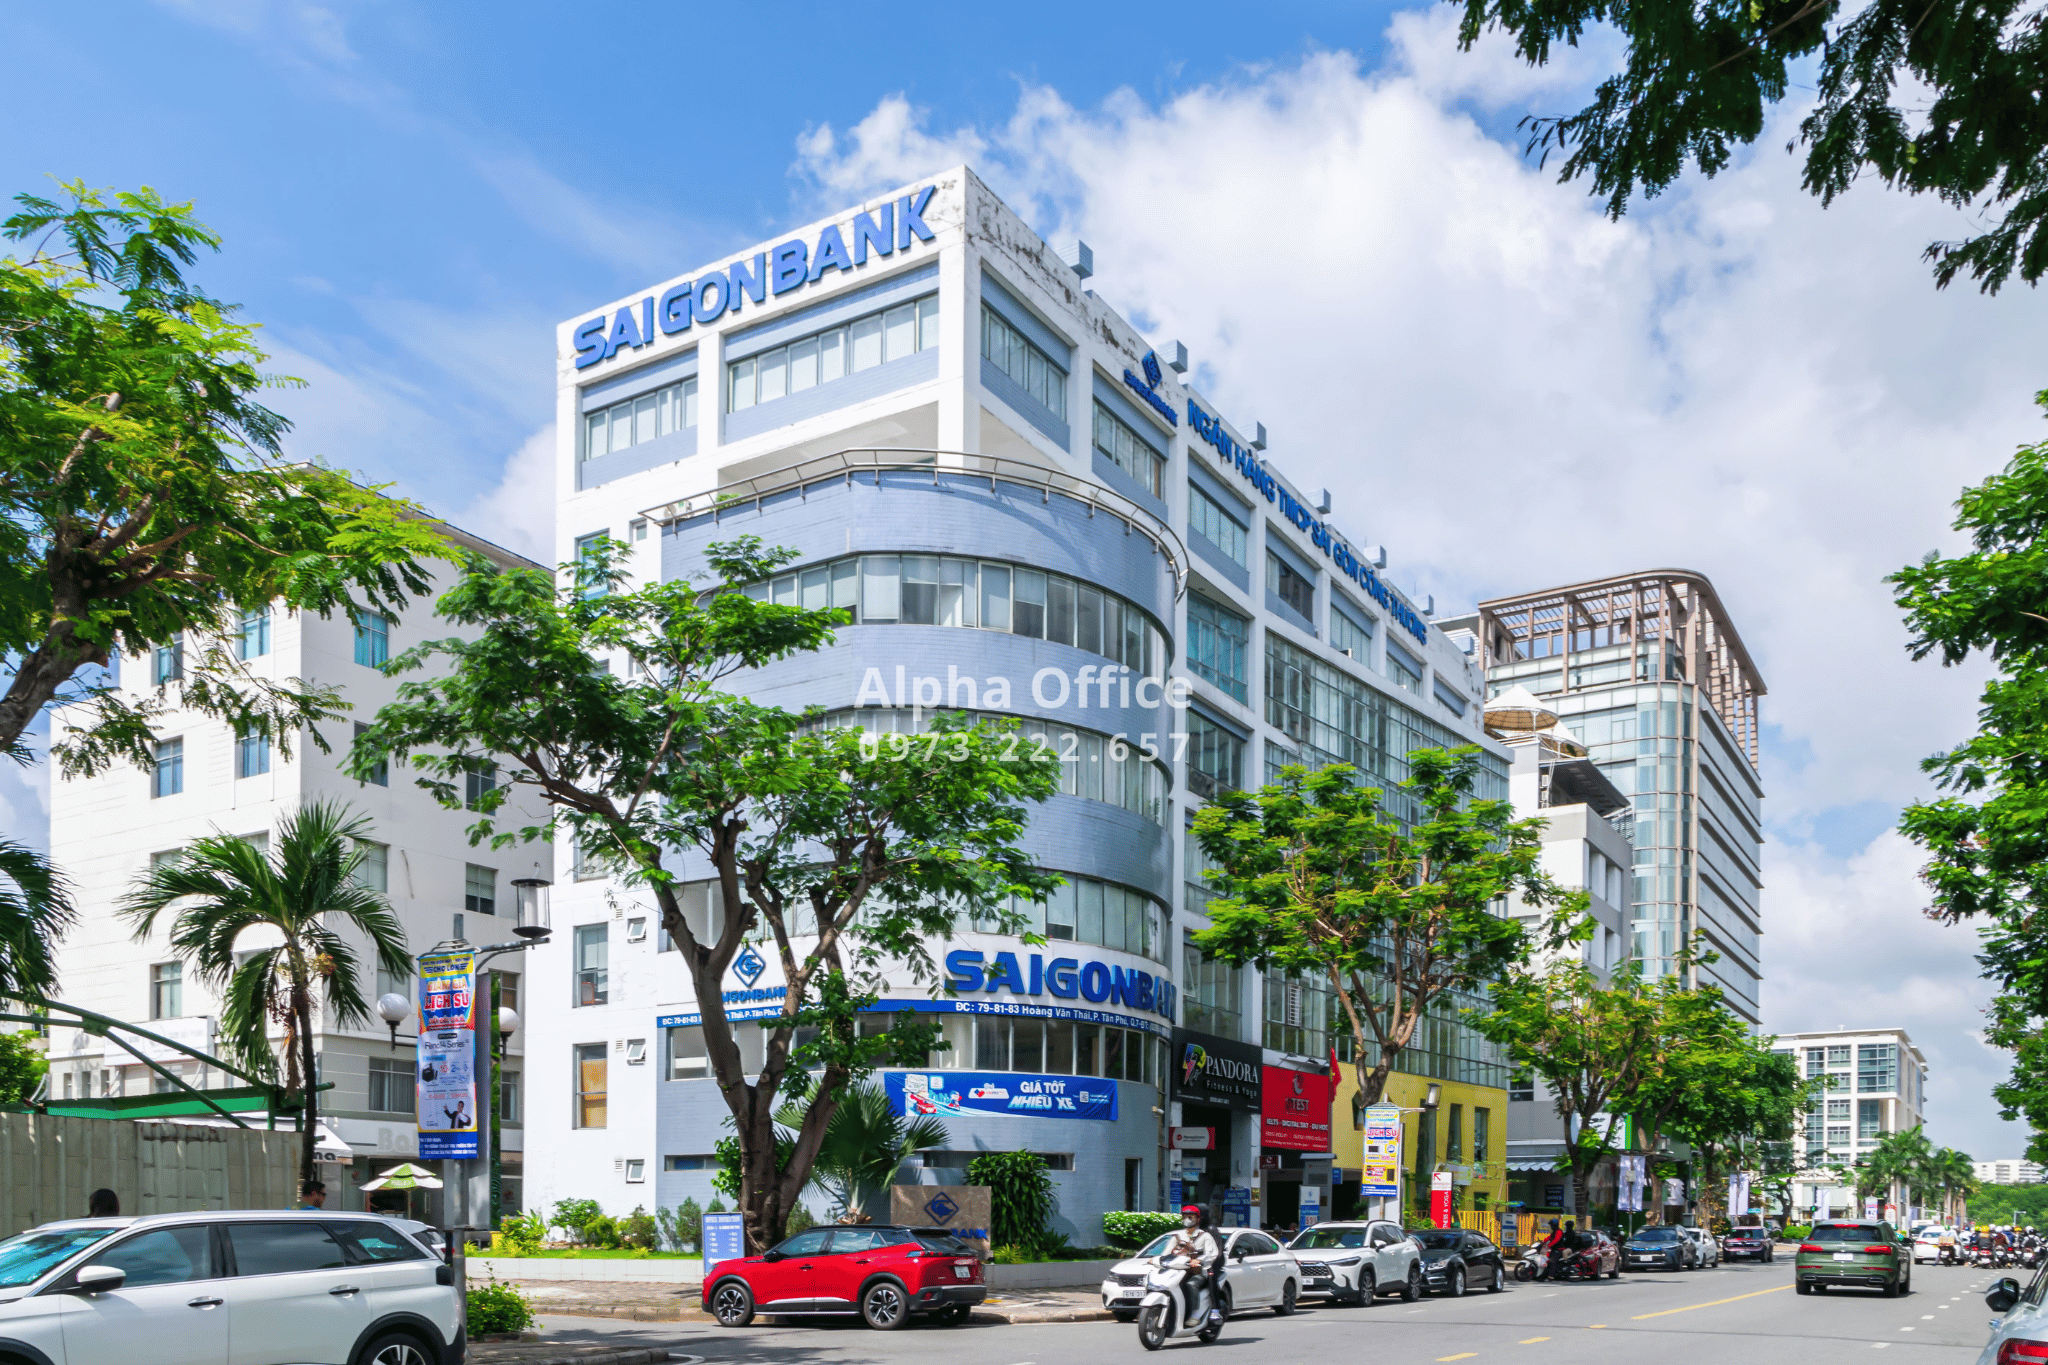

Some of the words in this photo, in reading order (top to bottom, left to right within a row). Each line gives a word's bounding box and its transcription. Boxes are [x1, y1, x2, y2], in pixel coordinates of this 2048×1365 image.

[573, 184, 936, 370] SAIGONBANK
[1187, 398, 1233, 463] NGÂN
[1235, 445, 1276, 503] HÀNG
[1311, 521, 1332, 557] SÀI
[1333, 542, 1358, 583] GÒN
[1359, 566, 1390, 610] CÔNG
[423, 994, 451, 1012] LỊCH
[956, 1002, 975, 1012] ĐC:
[977, 1003, 1020, 1014] 79-81-83
[1022, 1005, 1053, 1018] Hoàng
[1055, 1007, 1071, 1018] Văn
[1102, 1012, 1114, 1023] Tân
[674, 1015, 698, 1025] 79-81-83
[1205, 1055, 1259, 1084] PANDORA
[1020, 1079, 1043, 1094] GIÁ
[1044, 1080, 1066, 1095] TỐT
[1206, 1080, 1233, 1093] Fitness
[1235, 1086, 1240, 1094] &
[1242, 1087, 1258, 1099] Yoga
[1008, 1092, 1053, 1109] NHIỀU
[1055, 1096, 1077, 1110] XE
